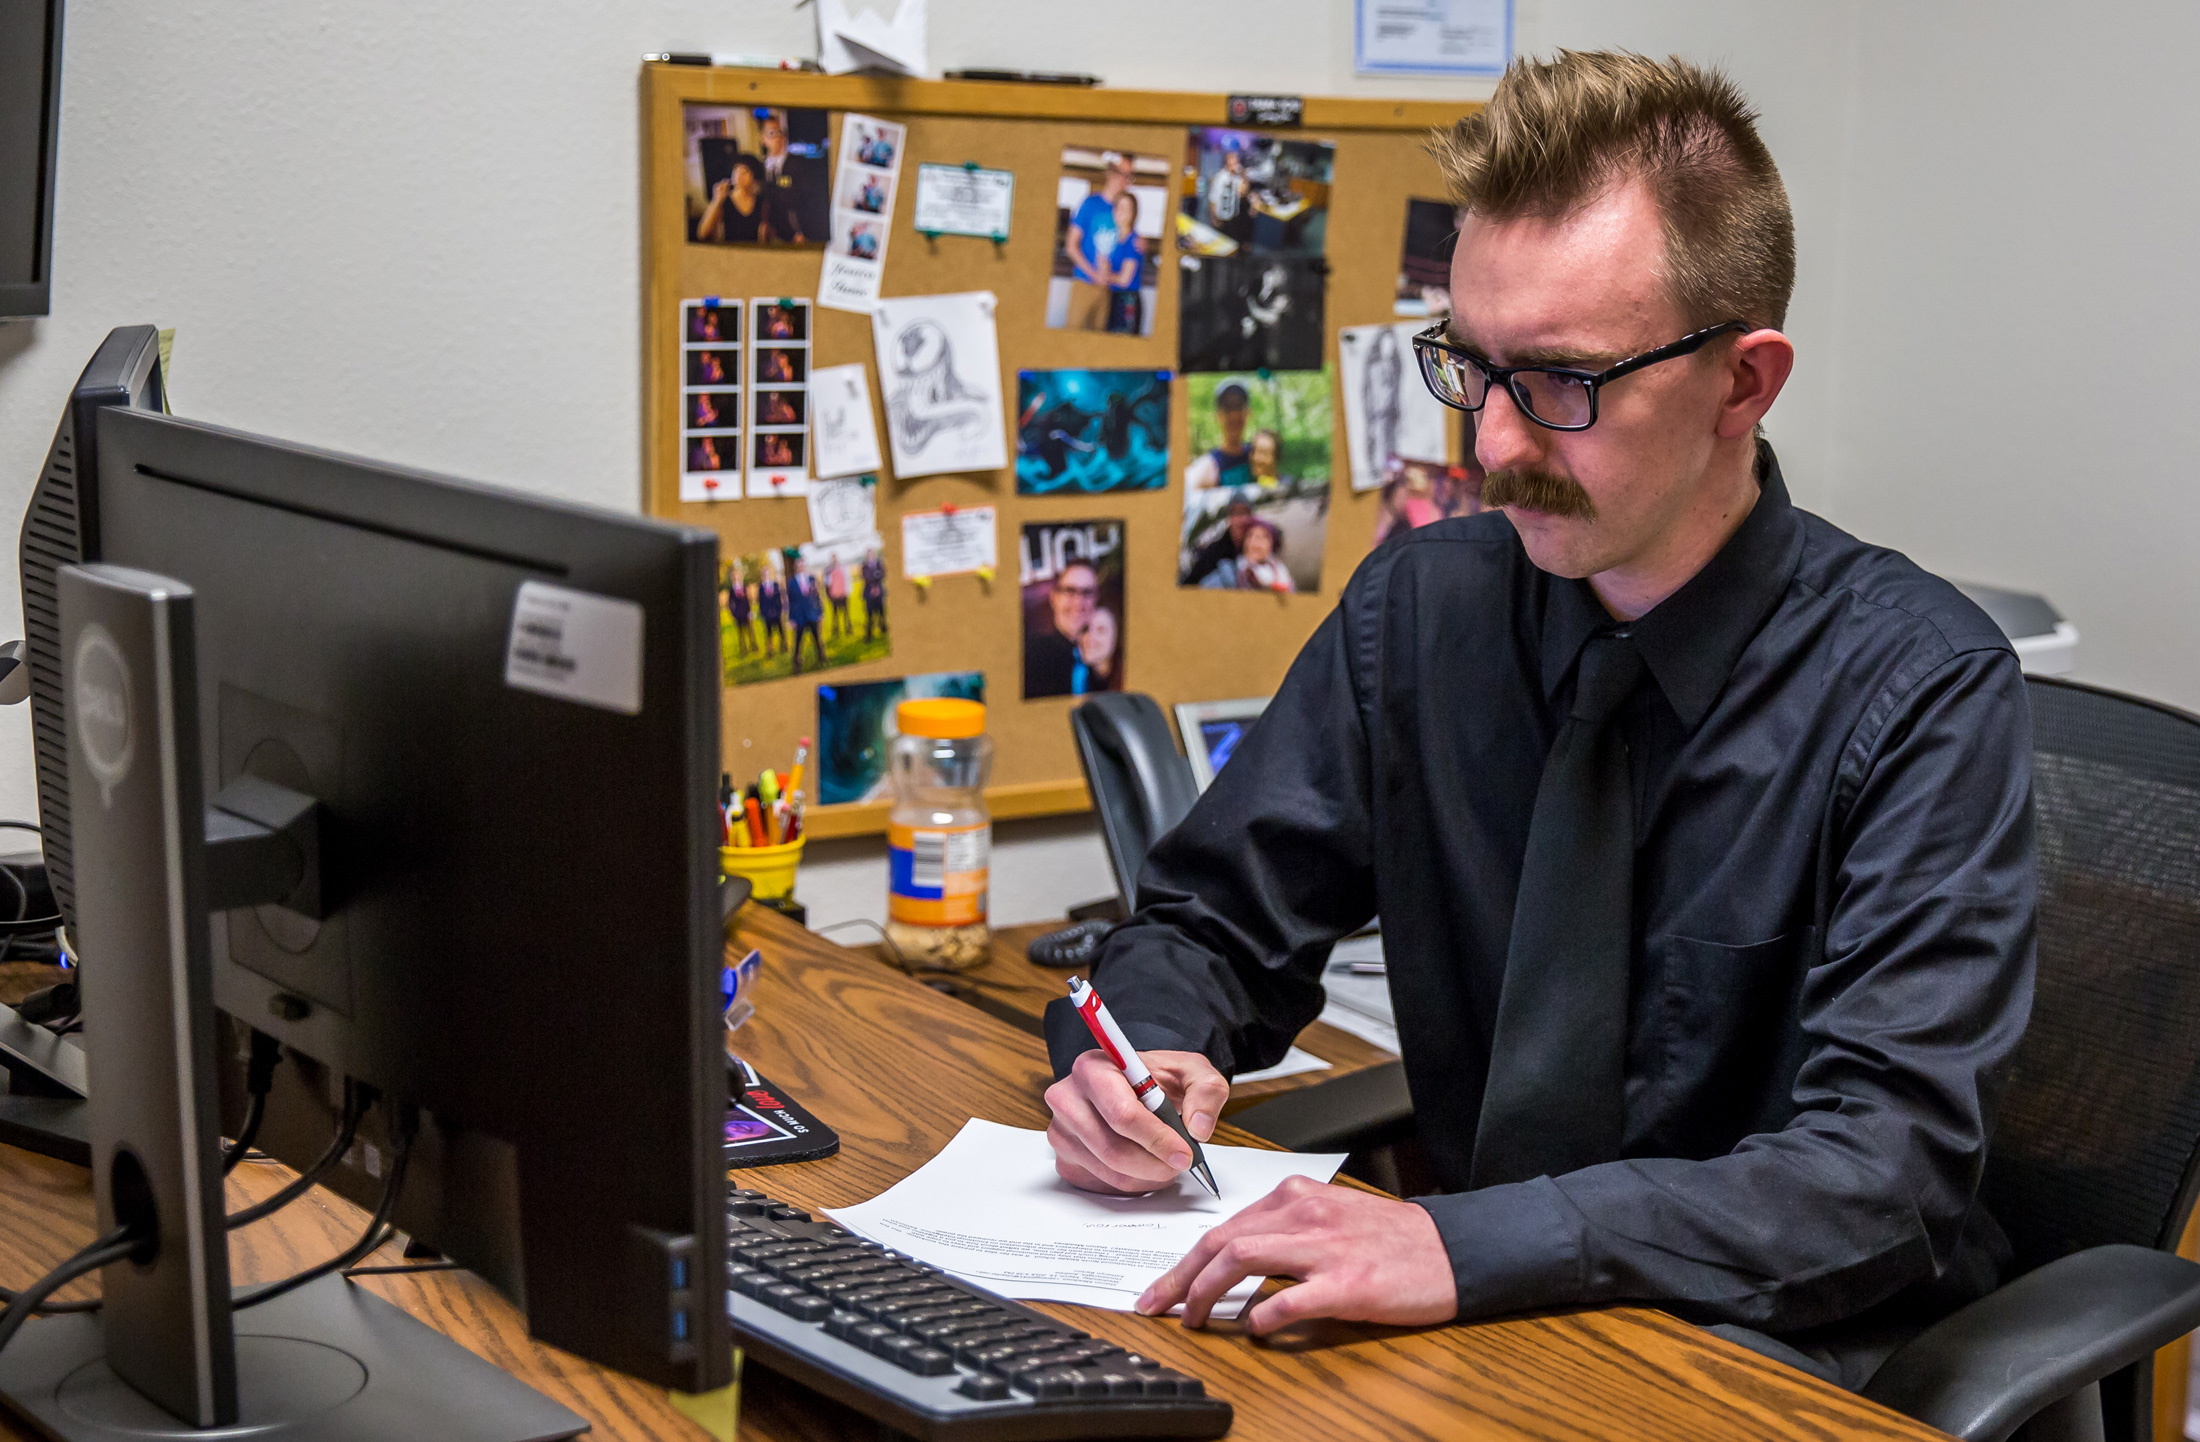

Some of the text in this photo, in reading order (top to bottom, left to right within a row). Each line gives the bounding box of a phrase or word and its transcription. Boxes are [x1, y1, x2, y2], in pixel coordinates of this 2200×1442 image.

[747, 1090, 809, 1134] SO MUCH love
